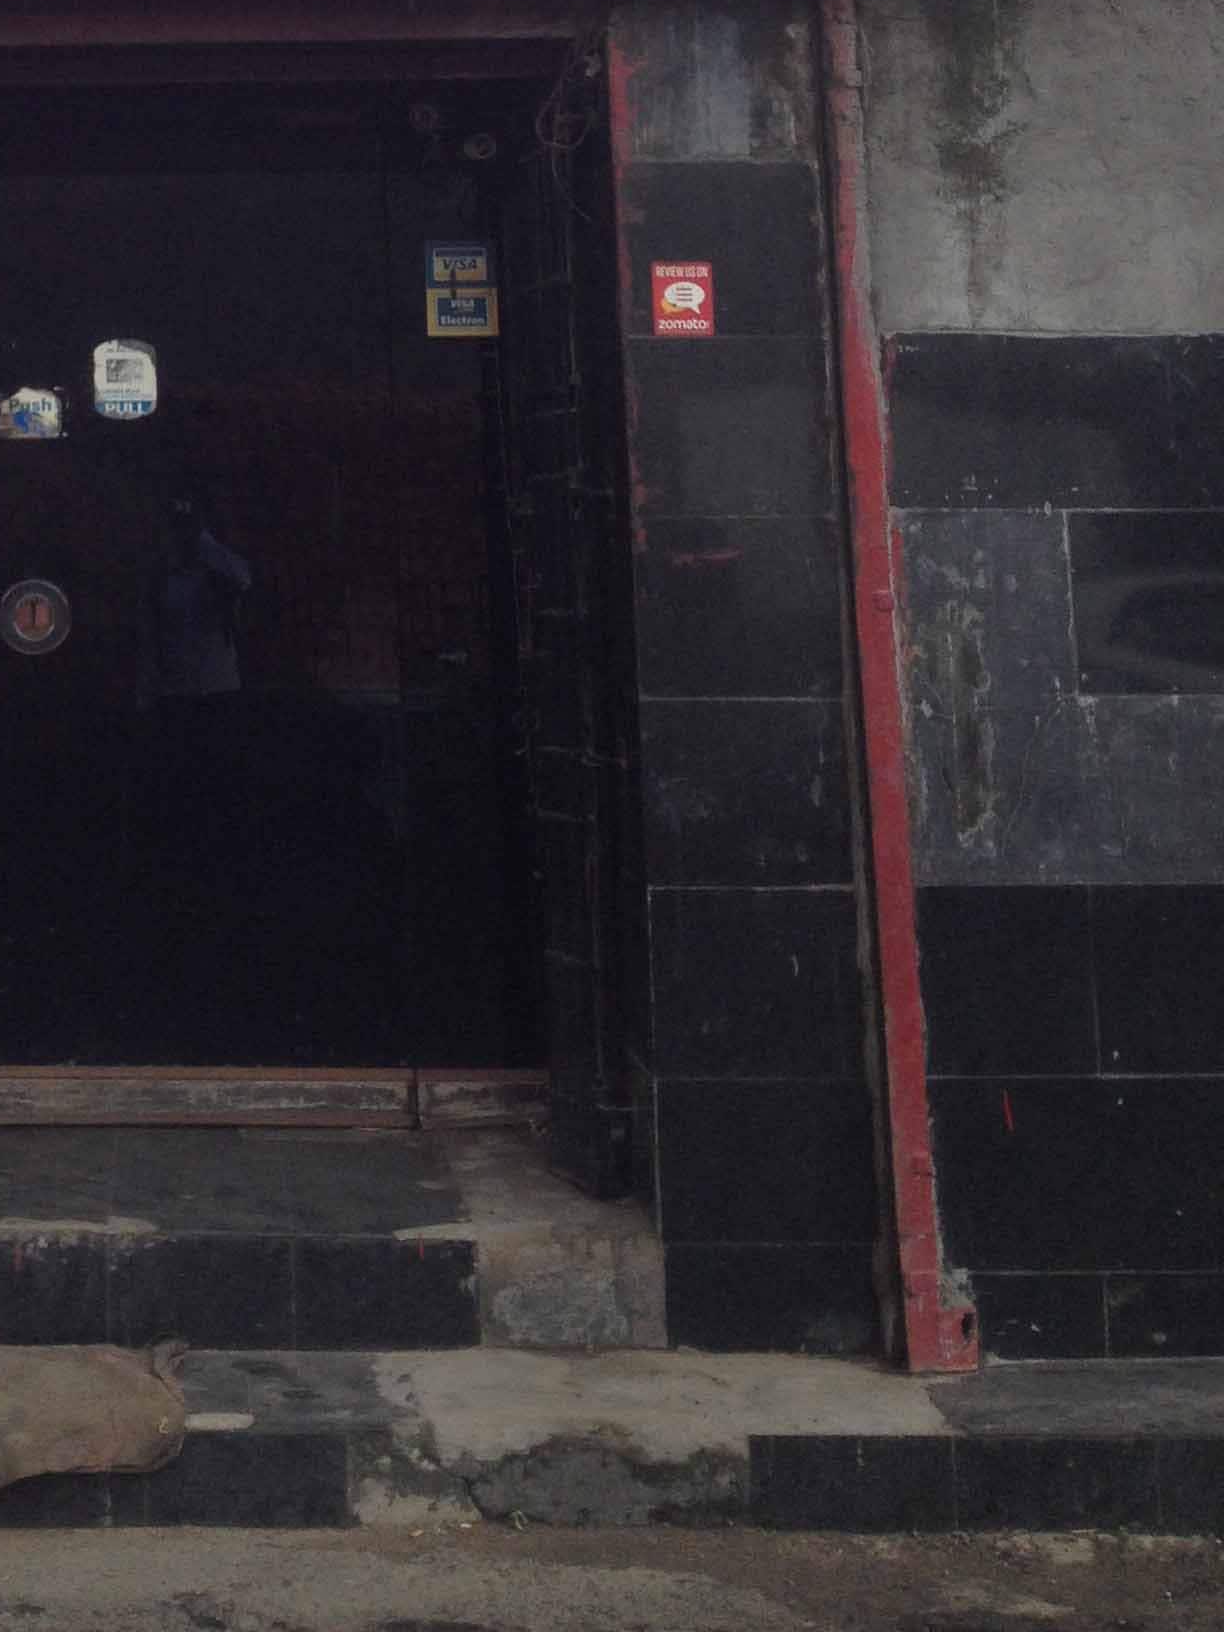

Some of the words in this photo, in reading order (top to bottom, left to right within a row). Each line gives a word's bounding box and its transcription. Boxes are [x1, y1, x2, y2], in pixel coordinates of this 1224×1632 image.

[441, 257, 478, 272] VISA
[440, 314, 485, 326] Electron
[658, 317, 707, 330] zomato
[9, 397, 52, 412] Push
